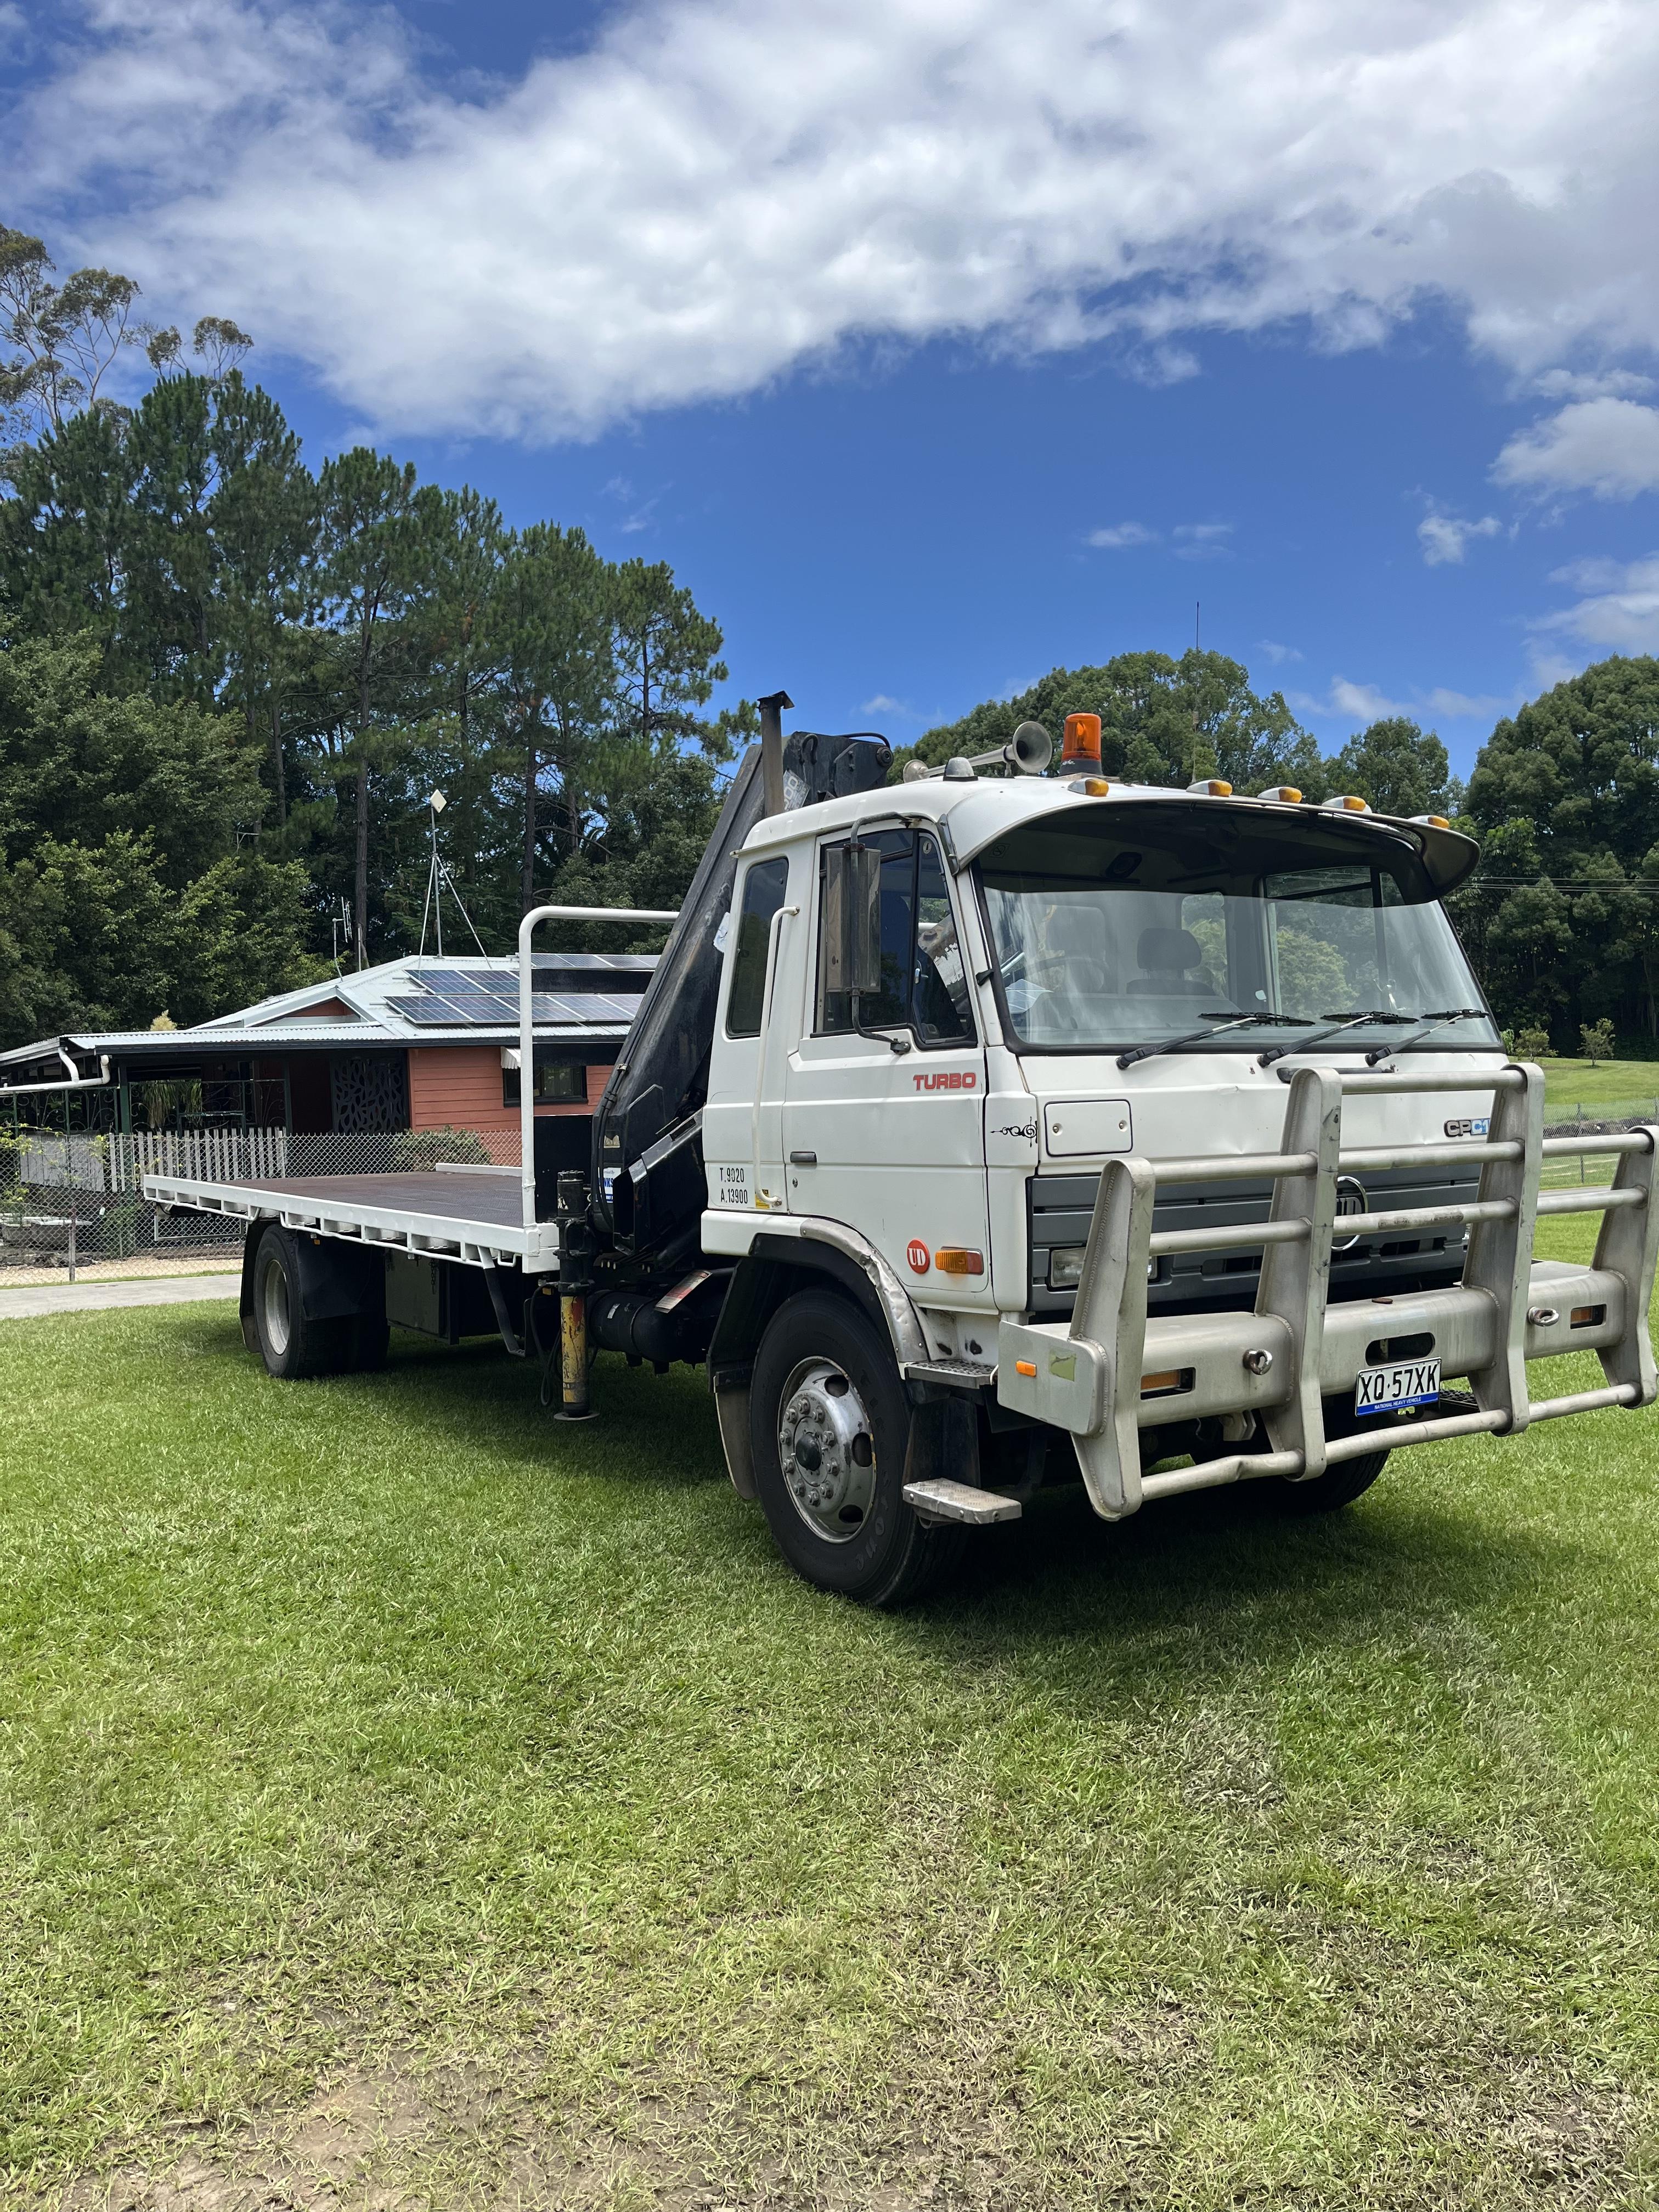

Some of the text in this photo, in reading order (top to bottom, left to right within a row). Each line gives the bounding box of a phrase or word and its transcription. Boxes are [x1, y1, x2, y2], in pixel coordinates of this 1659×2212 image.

[913, 1072, 976, 1091] TURBO
[1446, 1119, 1489, 1136] CPC1
[720, 1167, 744, 1183] T.9020
[721, 1188, 748, 1204] A.13900
[908, 1248, 926, 1266] UD
